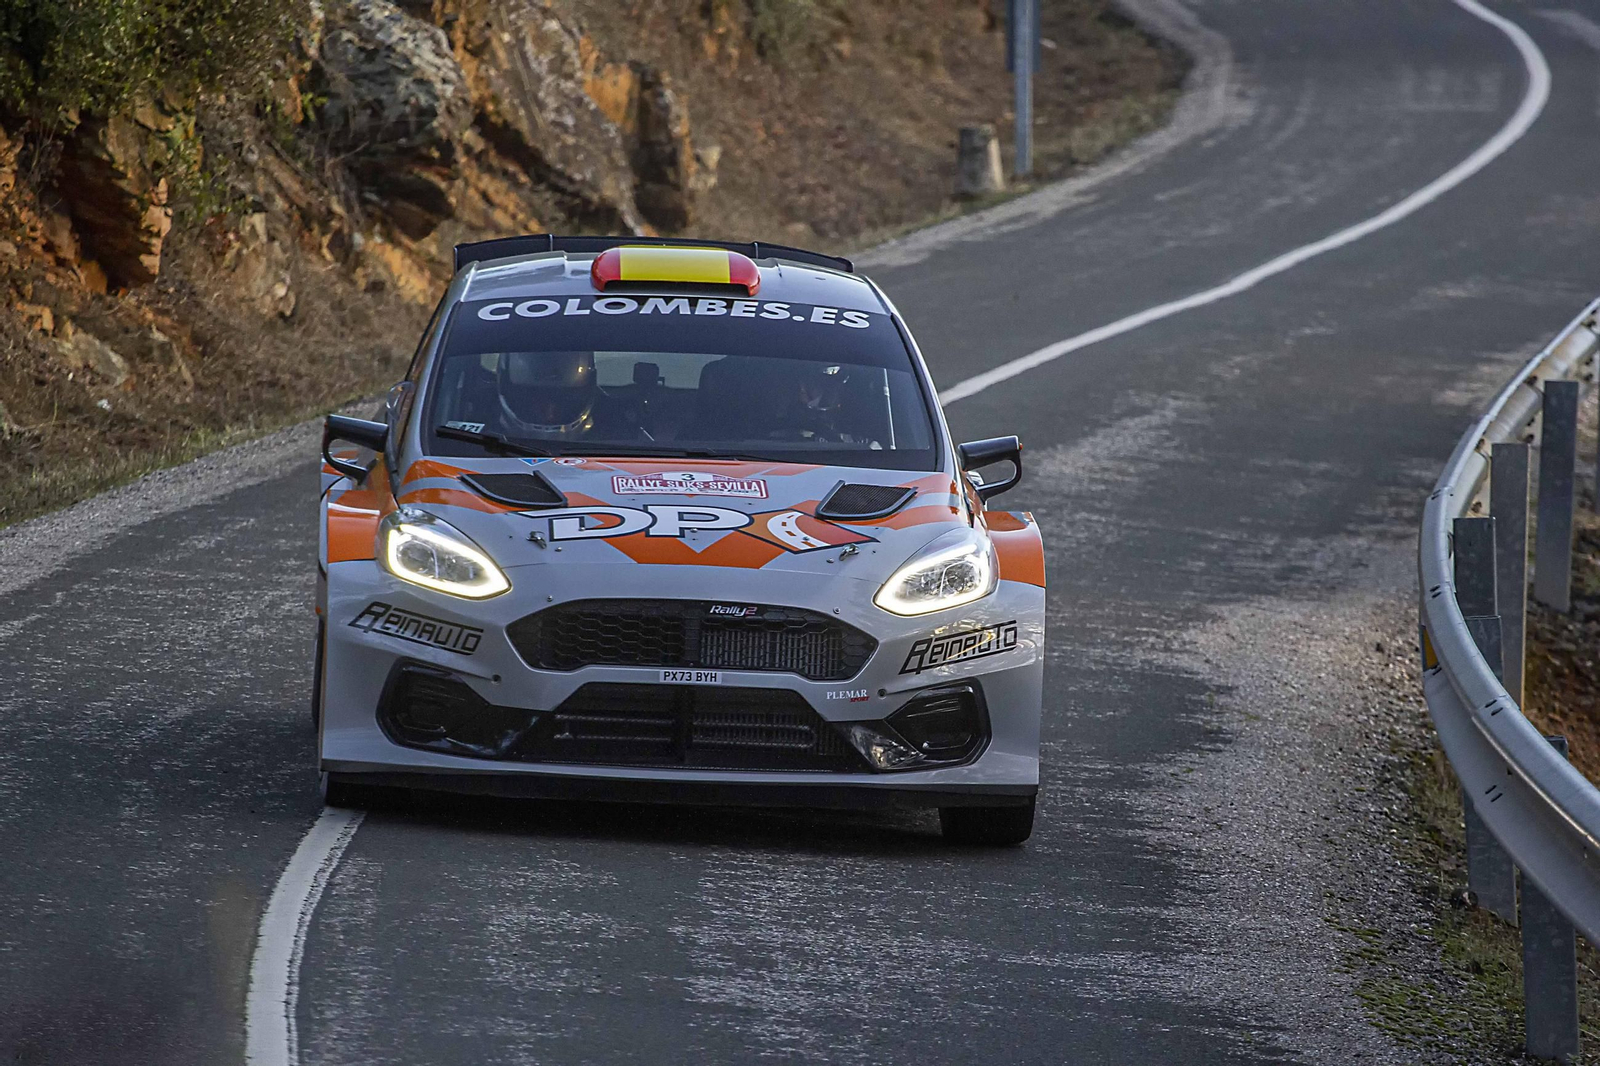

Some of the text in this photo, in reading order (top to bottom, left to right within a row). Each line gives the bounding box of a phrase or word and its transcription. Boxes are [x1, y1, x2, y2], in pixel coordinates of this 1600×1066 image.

[477, 297, 870, 329] COLOMBES.ES
[680, 473, 696, 481] 3
[618, 478, 664, 488] RALLYE
[709, 605, 758, 617] Rally2
[663, 671, 717, 683] PX73 BYH
[826, 689, 868, 700] PLEMAR
